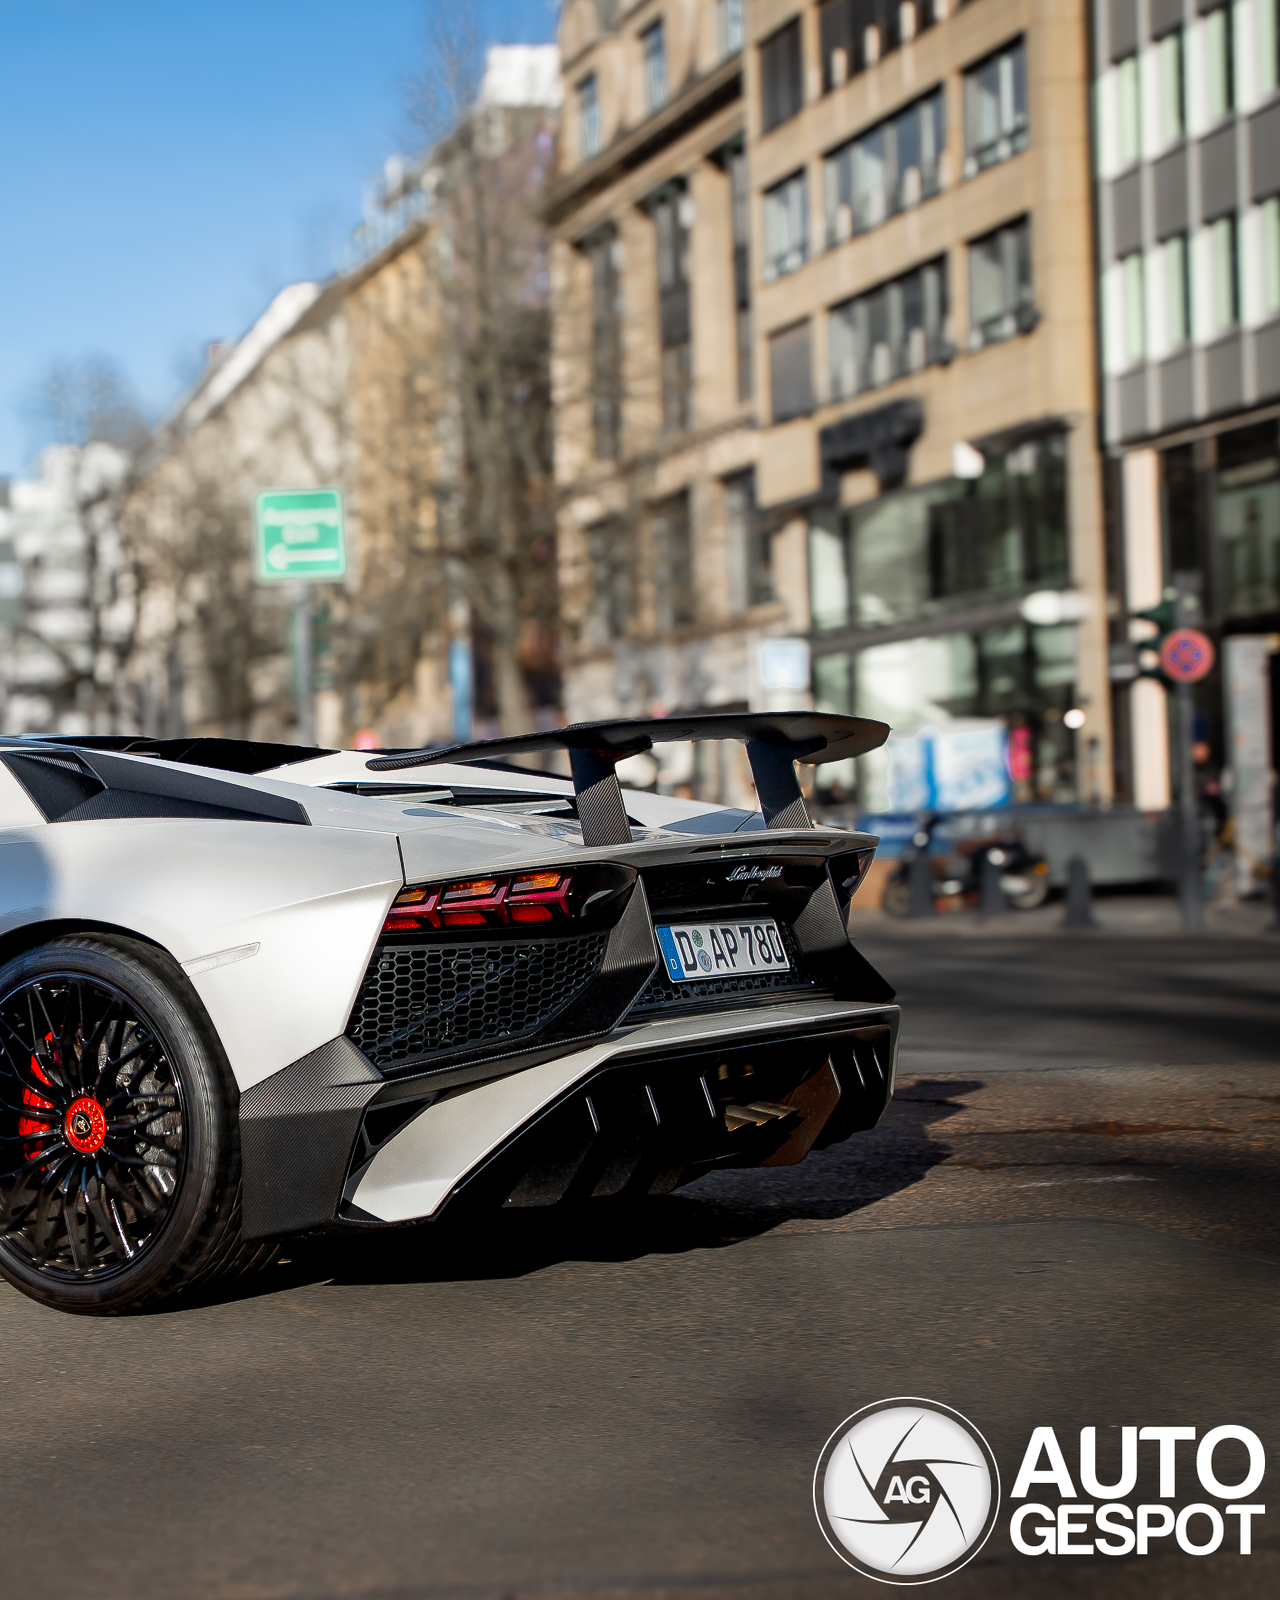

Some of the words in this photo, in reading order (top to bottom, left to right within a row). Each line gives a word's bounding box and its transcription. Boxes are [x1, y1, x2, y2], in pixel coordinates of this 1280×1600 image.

[674, 931, 698, 972] D
[709, 928, 738, 969] AP
[738, 925, 786, 965] 780
[670, 958, 678, 970] D
